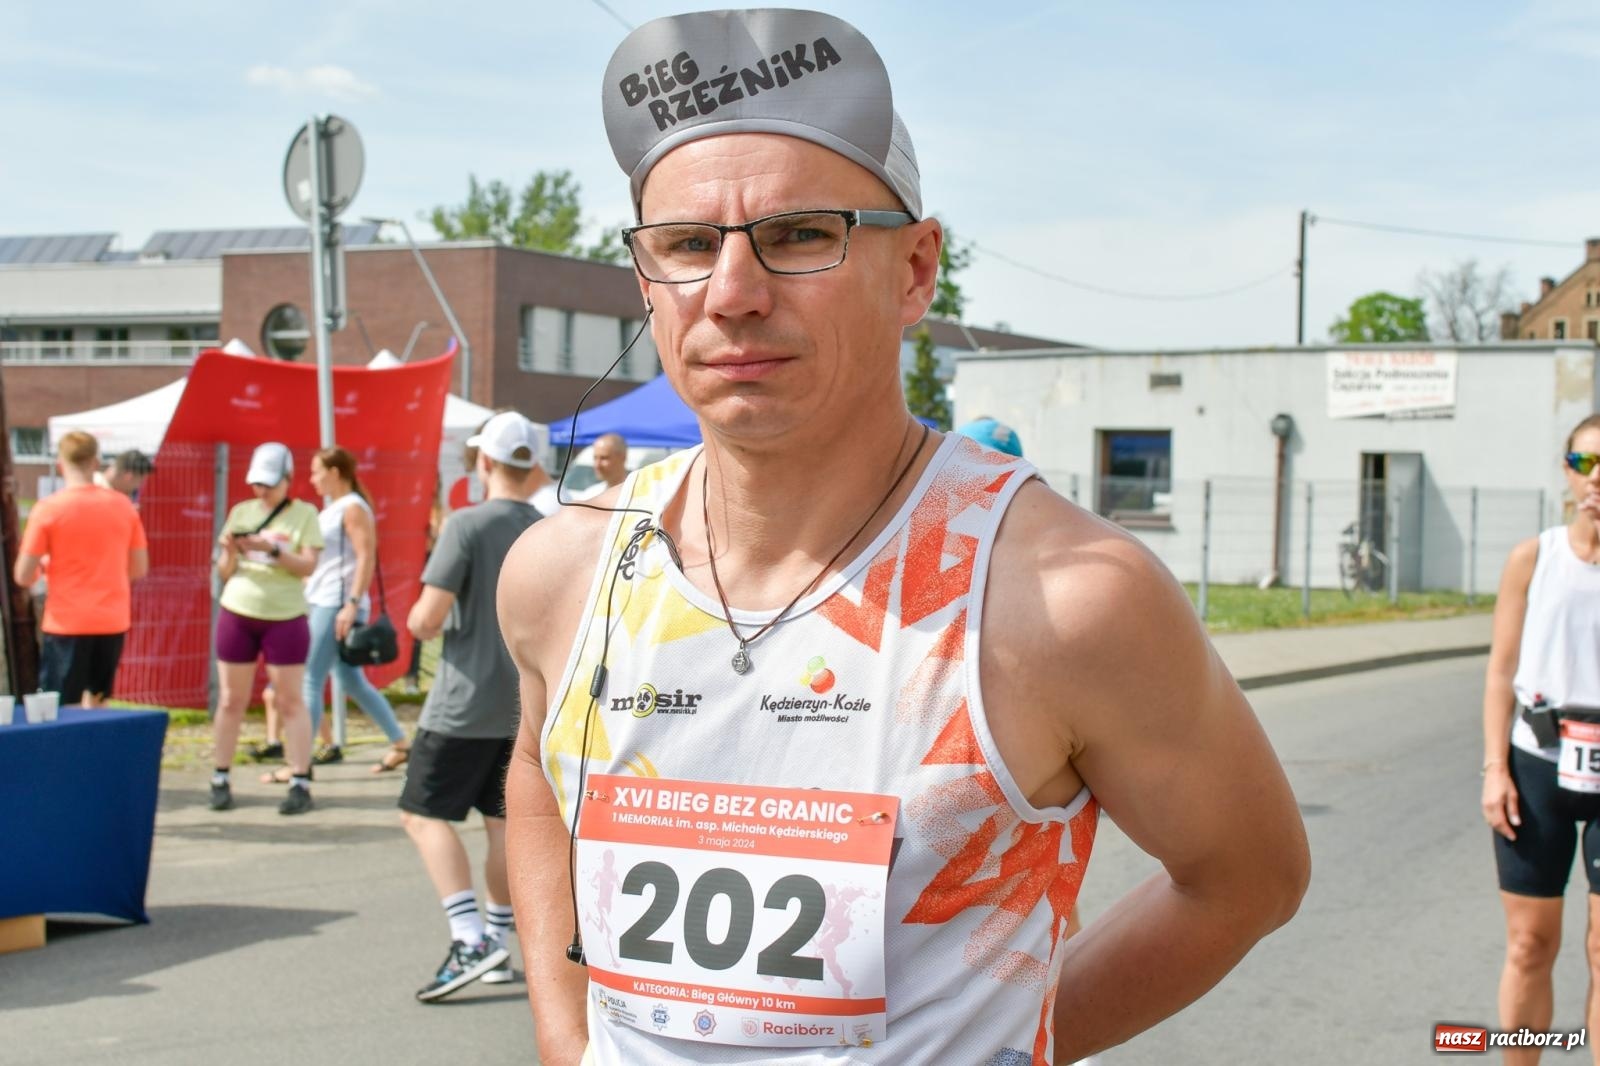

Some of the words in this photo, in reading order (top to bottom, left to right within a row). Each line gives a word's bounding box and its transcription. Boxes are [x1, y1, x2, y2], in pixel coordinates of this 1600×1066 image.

[760, 694, 871, 713] Kędzierzyn-Koźle
[777, 715, 802, 723] Miasto
[804, 714, 849, 723] możliwości
[612, 786, 654, 809] XVI
[656, 790, 710, 813] BIEG
[713, 794, 757, 817] BEZ
[760, 798, 854, 825] GRANIC
[618, 813, 674, 828] MEMORIAŁ
[676, 817, 694, 829] im.
[695, 821, 719, 833] asp.
[722, 821, 767, 835] Michała
[769, 825, 849, 844] Kędzierskiego
[698, 835, 705, 845] 3
[706, 838, 731, 849] maja
[732, 838, 755, 848] 2024
[619, 860, 827, 981] 202
[633, 981, 690, 998] KATEGORIA:
[691, 990, 715, 1004] Bieg
[717, 993, 759, 1009] Główny
[762, 997, 773, 1008] 10
[776, 998, 796, 1010] km
[763, 1021, 835, 1036] Racibórz
